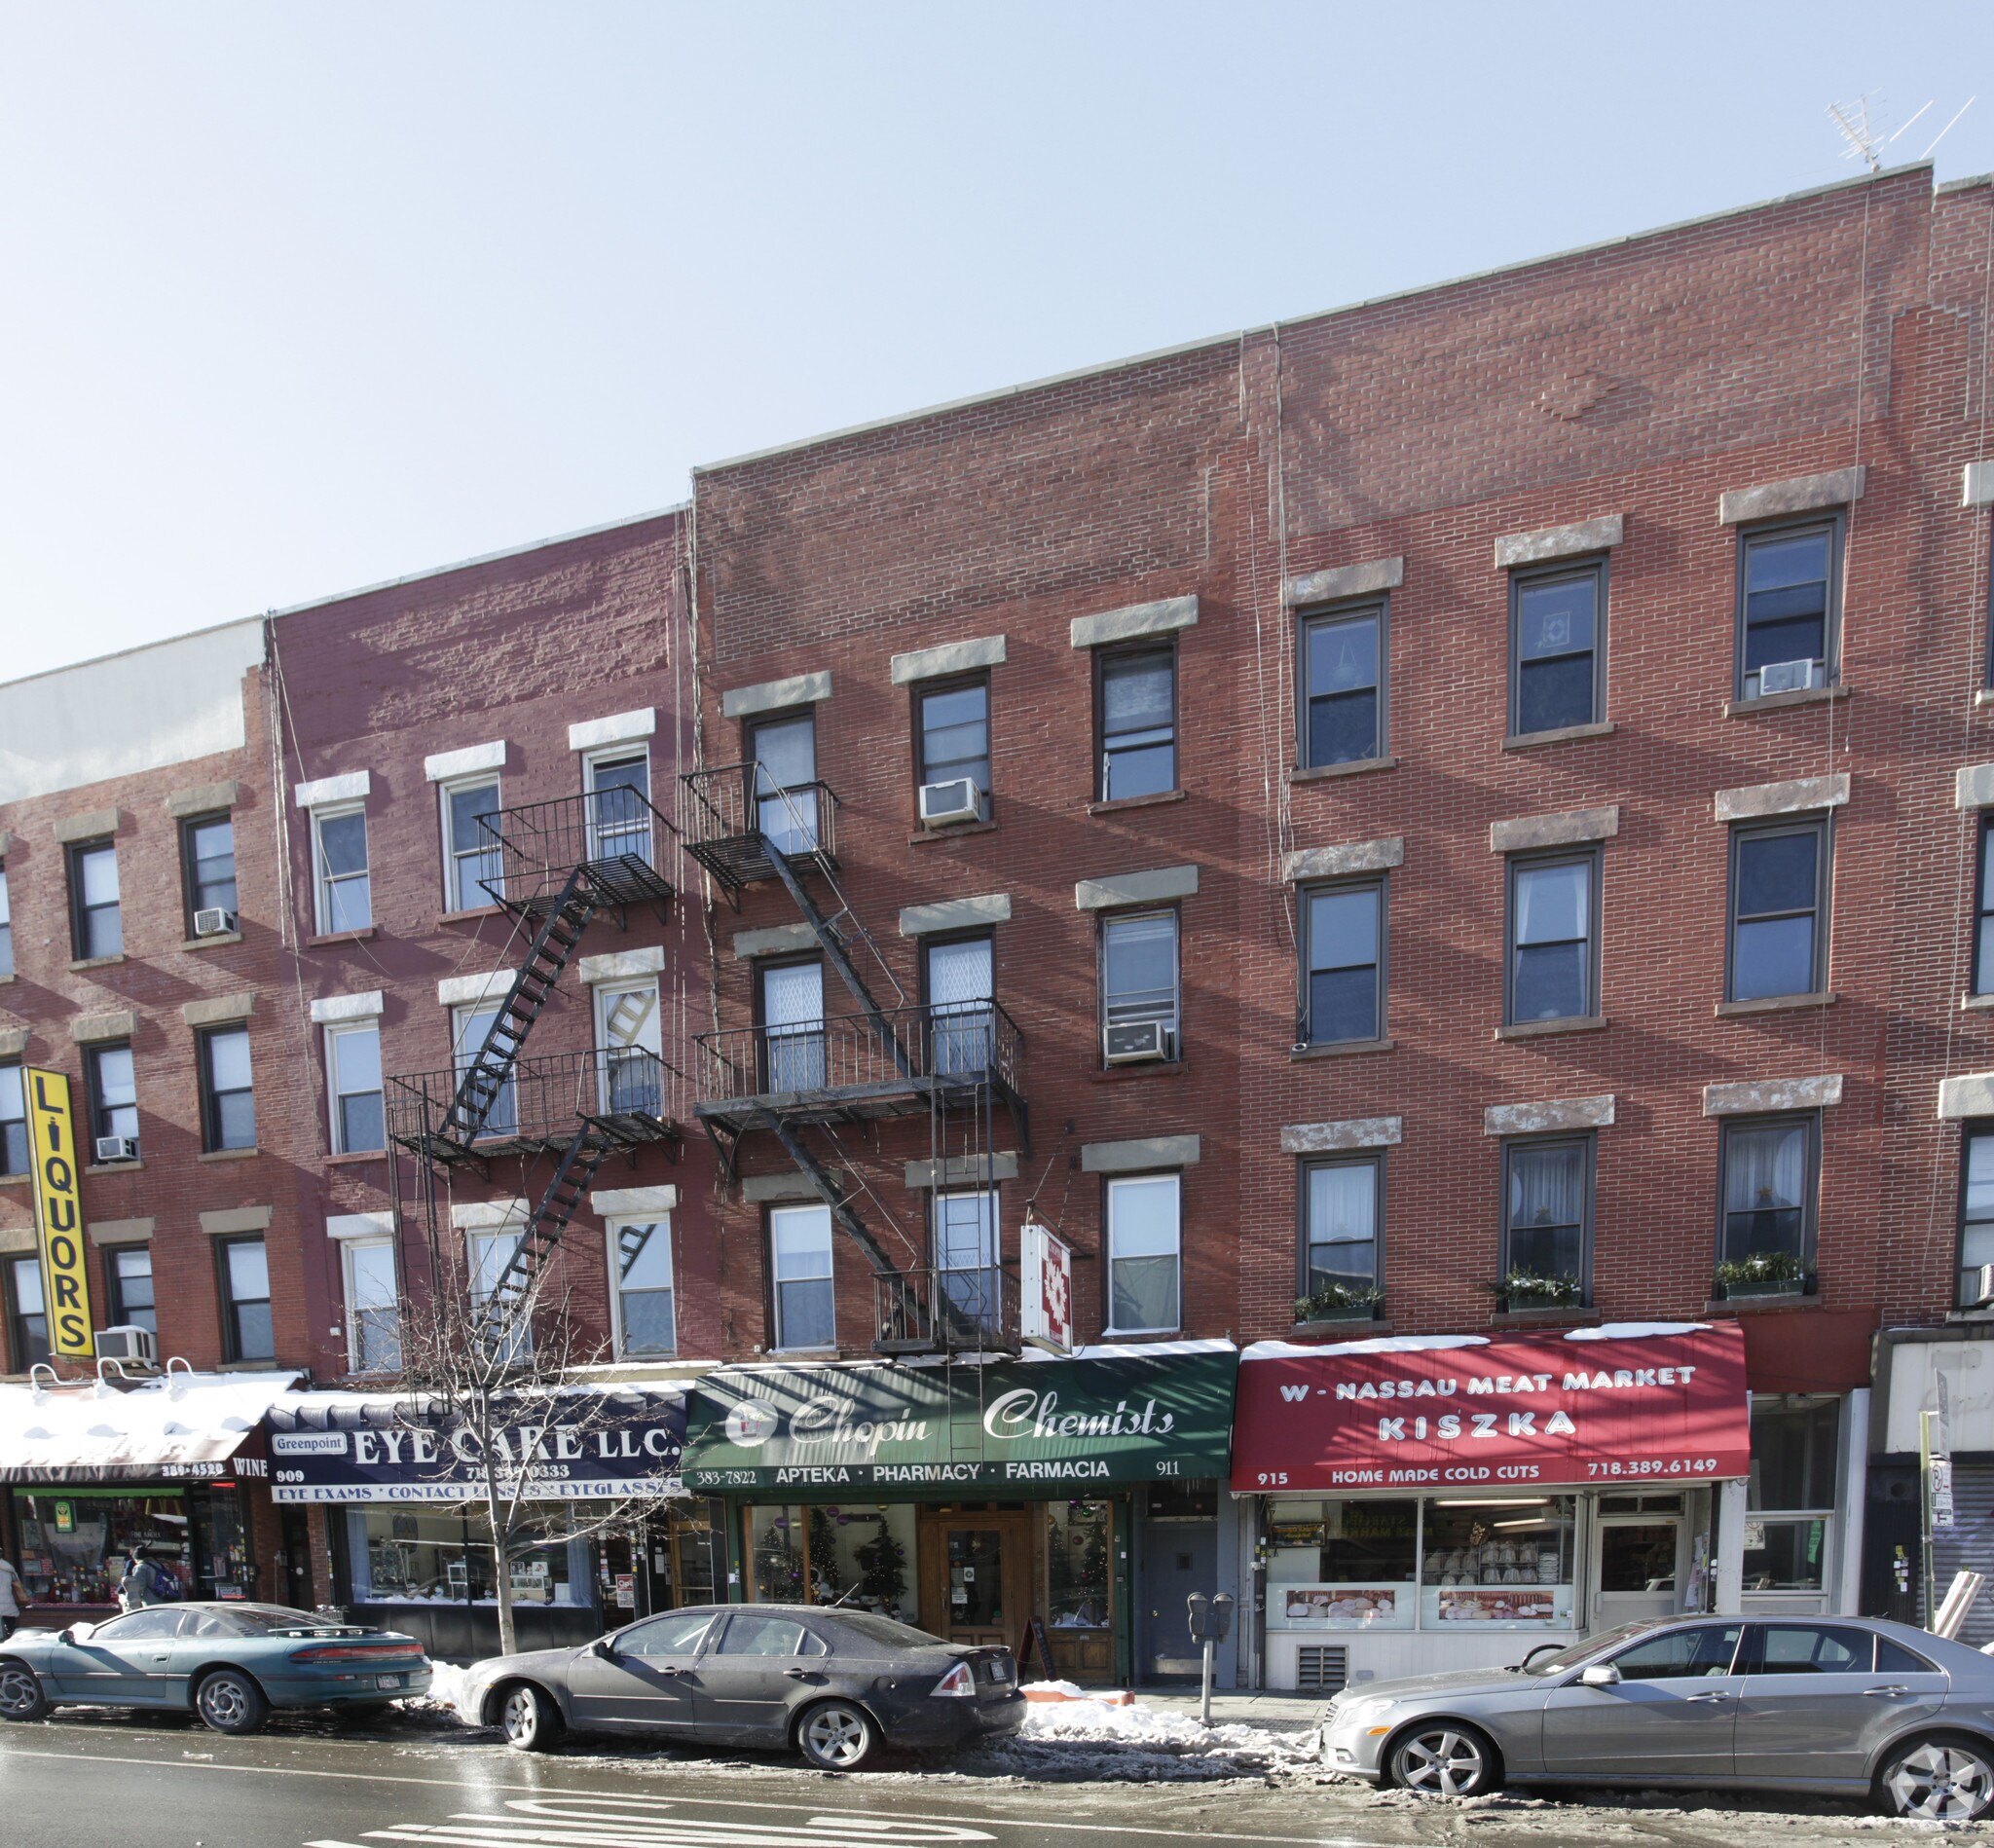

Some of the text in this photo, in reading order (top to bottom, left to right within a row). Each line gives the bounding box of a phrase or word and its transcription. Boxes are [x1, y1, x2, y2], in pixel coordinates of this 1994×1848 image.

[35, 1076, 86, 1348] LIQUORS
[1279, 1385, 1310, 1402] W
[1336, 1378, 1458, 1400] NASSAU
[1466, 1374, 1553, 1395] MEAT
[1562, 1366, 1697, 1390] MARKET
[982, 1388, 1175, 1439] Chemists
[789, 1395, 933, 1457] Chopin
[1379, 1410, 1576, 1441] KISZKA
[277, 1437, 342, 1453] Greenpoint
[353, 1424, 681, 1464] EYE CARE LLC.
[233, 1458, 268, 1477] WINE
[276, 1470, 305, 1483] 909
[776, 1460, 1110, 1483] APTEKA PHARMACY FARMACIA
[1156, 1461, 1180, 1476] 911
[1332, 1464, 1540, 1484] HOME MADE COLD CUTS
[1587, 1459, 1717, 1477] 718.389.6149
[696, 1470, 757, 1486] 383-7822
[1257, 1472, 1288, 1485] 915
[278, 1489, 309, 1500] EYE
[314, 1488, 372, 1499] EXAMS
[388, 1486, 466, 1498] CONTACT
[559, 1481, 682, 1496] EYEGLASSES
